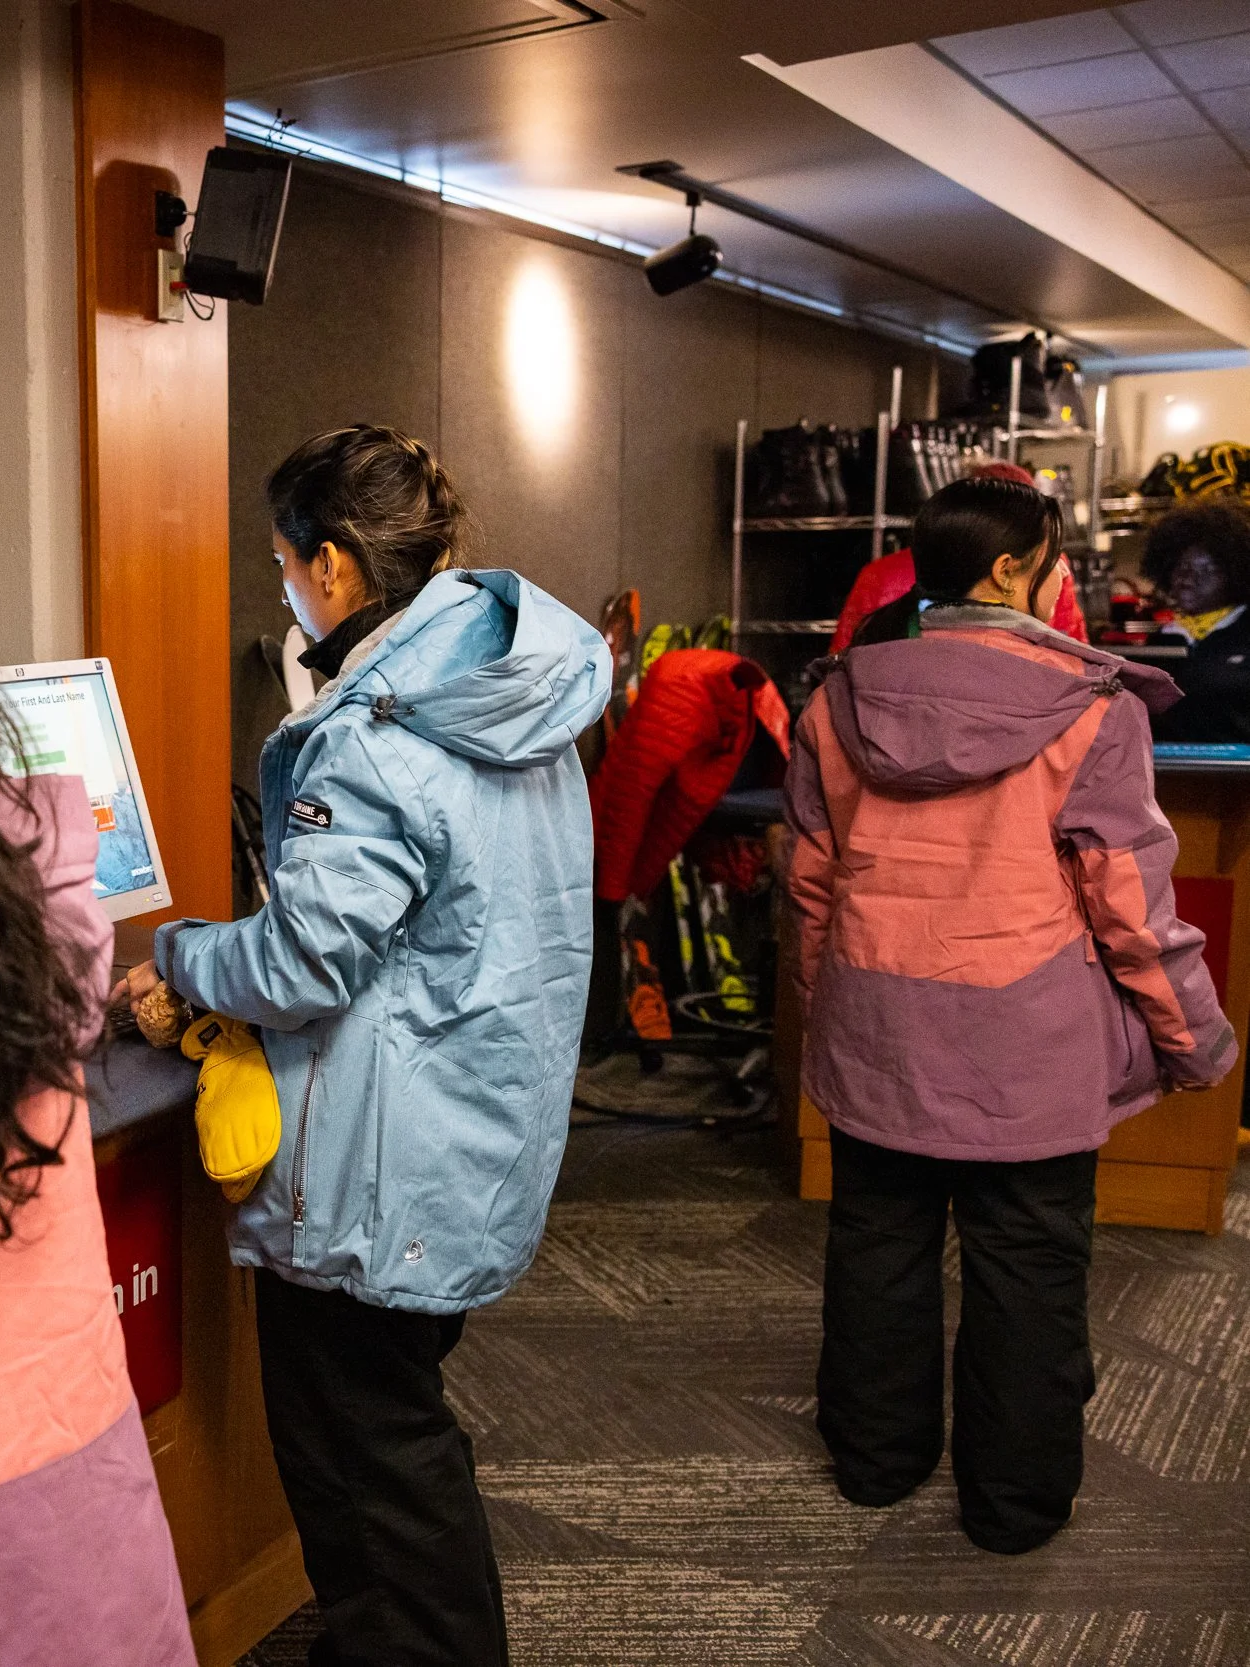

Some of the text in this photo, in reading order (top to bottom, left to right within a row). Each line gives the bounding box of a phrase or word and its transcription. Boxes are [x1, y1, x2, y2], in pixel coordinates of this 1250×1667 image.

[21, 697, 37, 706] First
[38, 695, 51, 705] And
[51, 694, 66, 703] Last
[66, 691, 85, 701] Name
[133, 1263, 158, 1306] in
